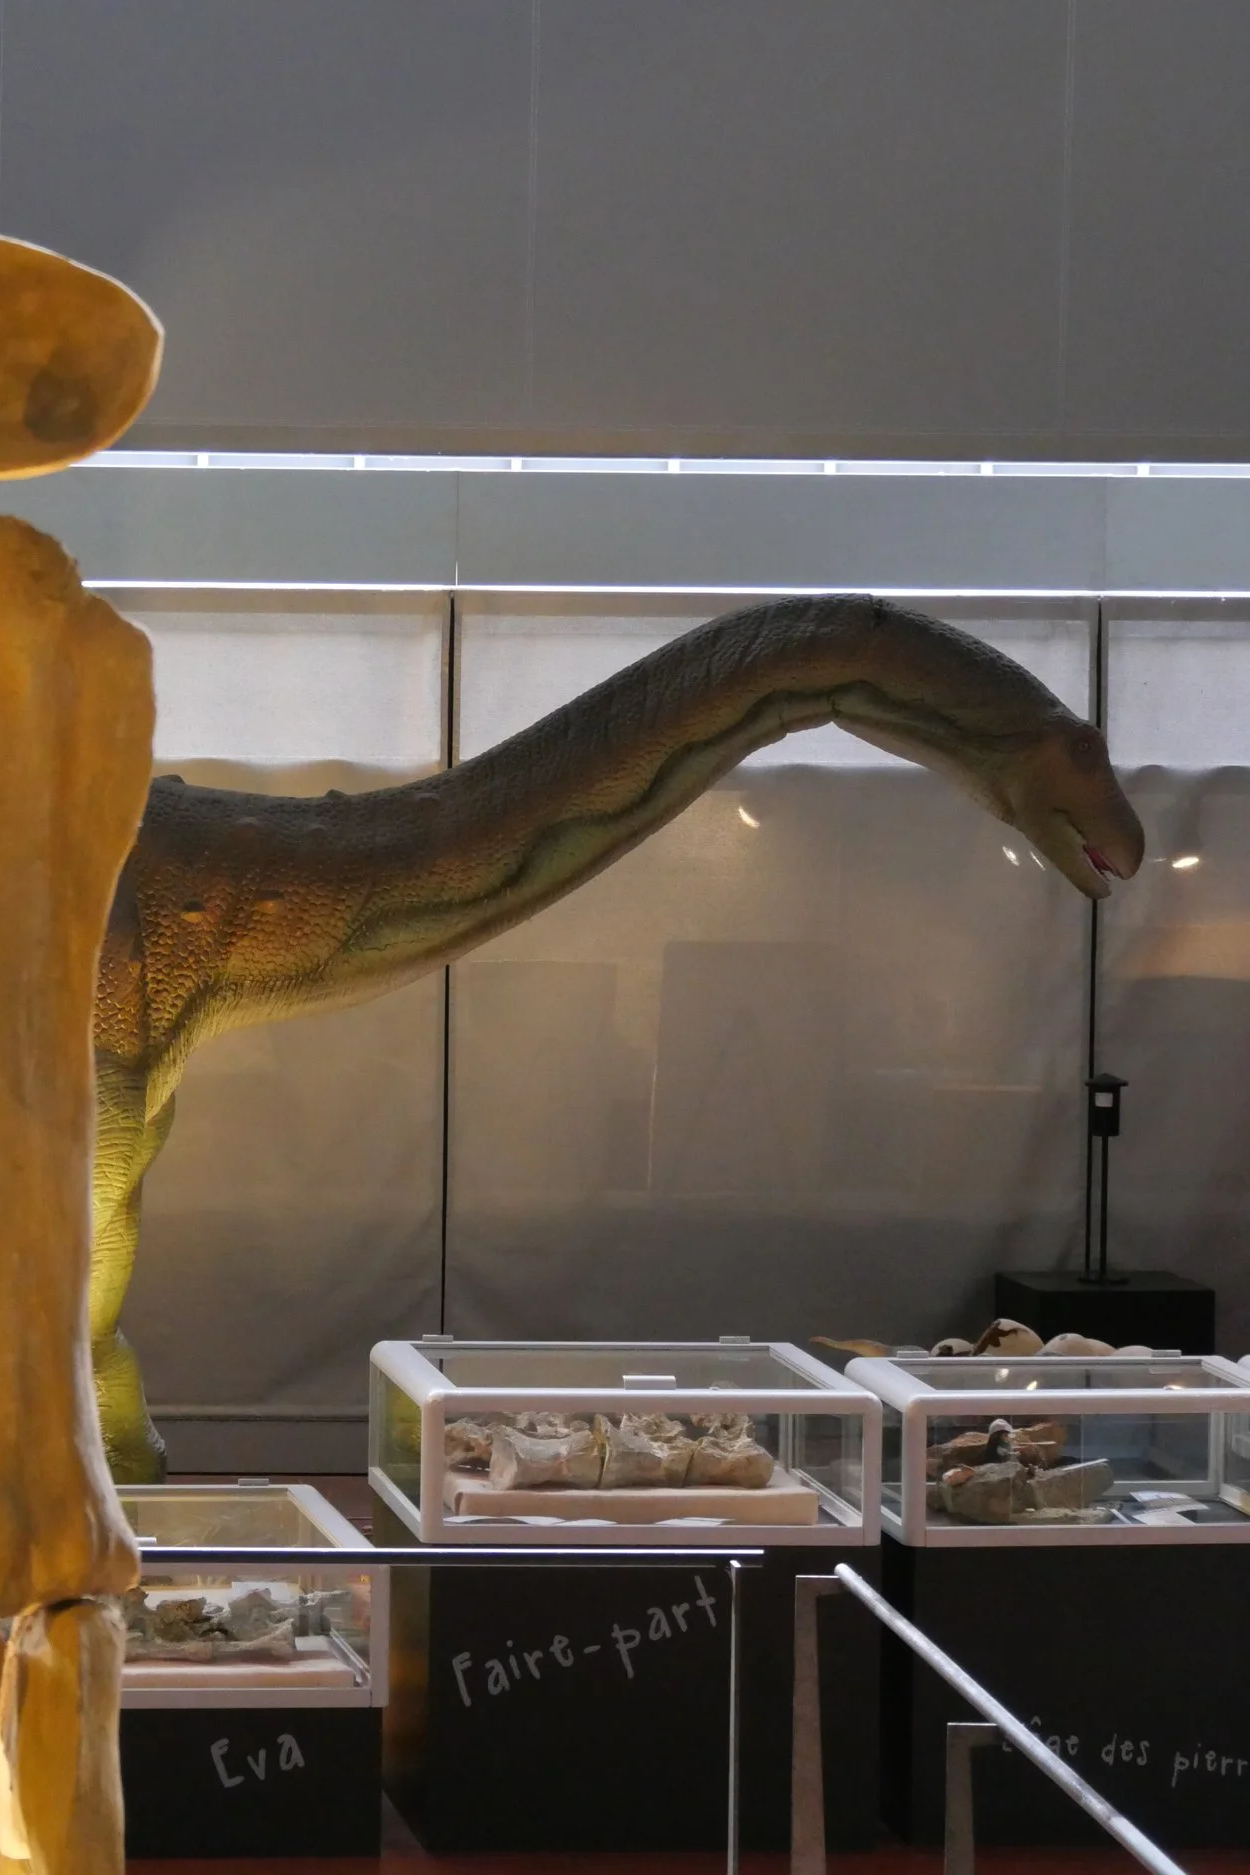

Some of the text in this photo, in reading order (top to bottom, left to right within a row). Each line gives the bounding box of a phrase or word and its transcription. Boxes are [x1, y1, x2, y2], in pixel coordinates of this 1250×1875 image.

[452, 1575, 717, 1707] Faire-part
[210, 1733, 305, 1788] Eva
[1101, 1733, 1150, 1766] des
